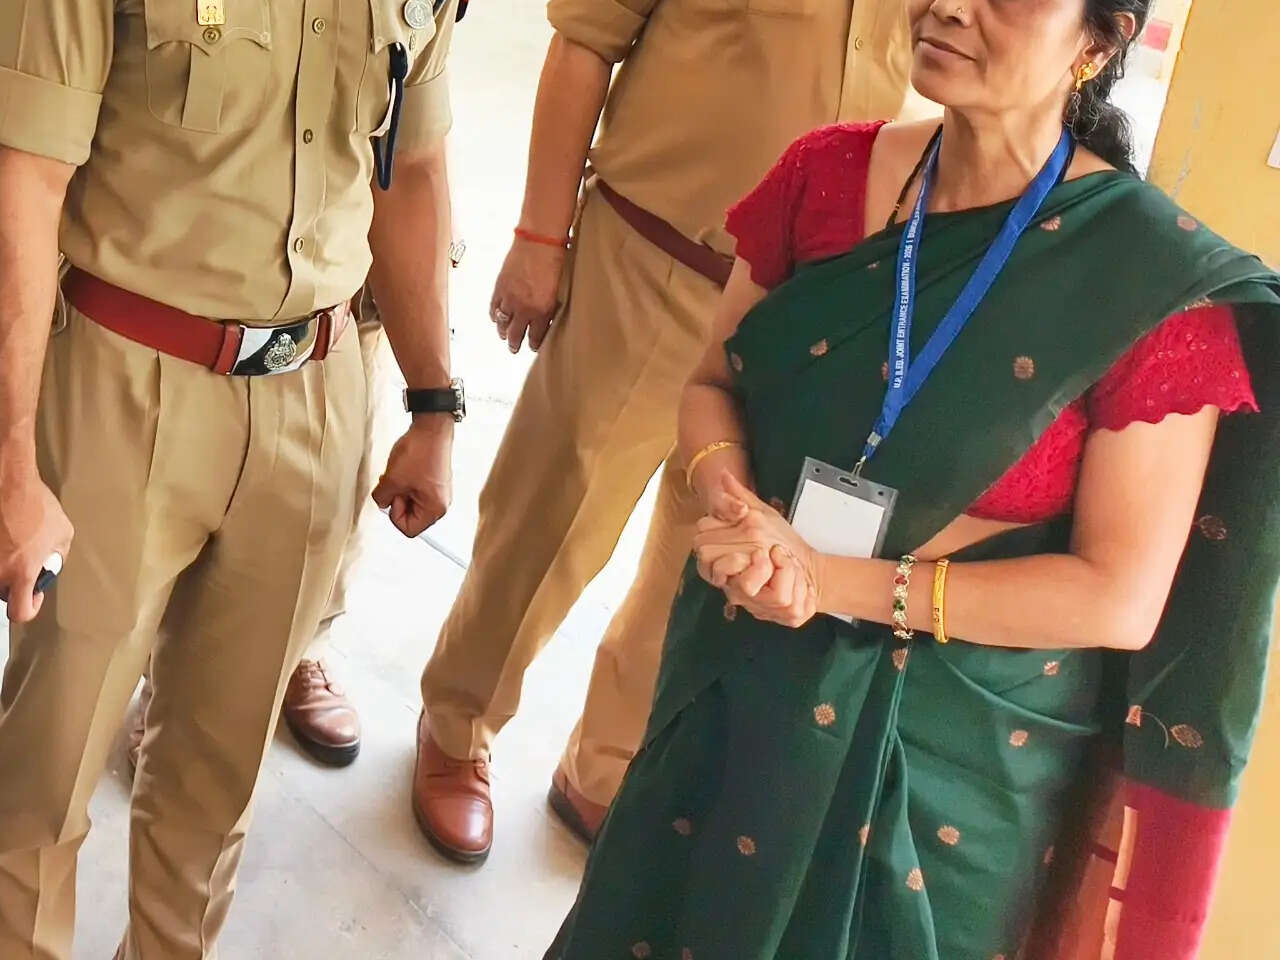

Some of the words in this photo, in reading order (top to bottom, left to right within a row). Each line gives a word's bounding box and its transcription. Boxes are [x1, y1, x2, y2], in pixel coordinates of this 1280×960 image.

[900, 262, 910, 304] EXAMINATION
[896, 304, 909, 338] ENTRANCE
[896, 339, 905, 357] JOINT
